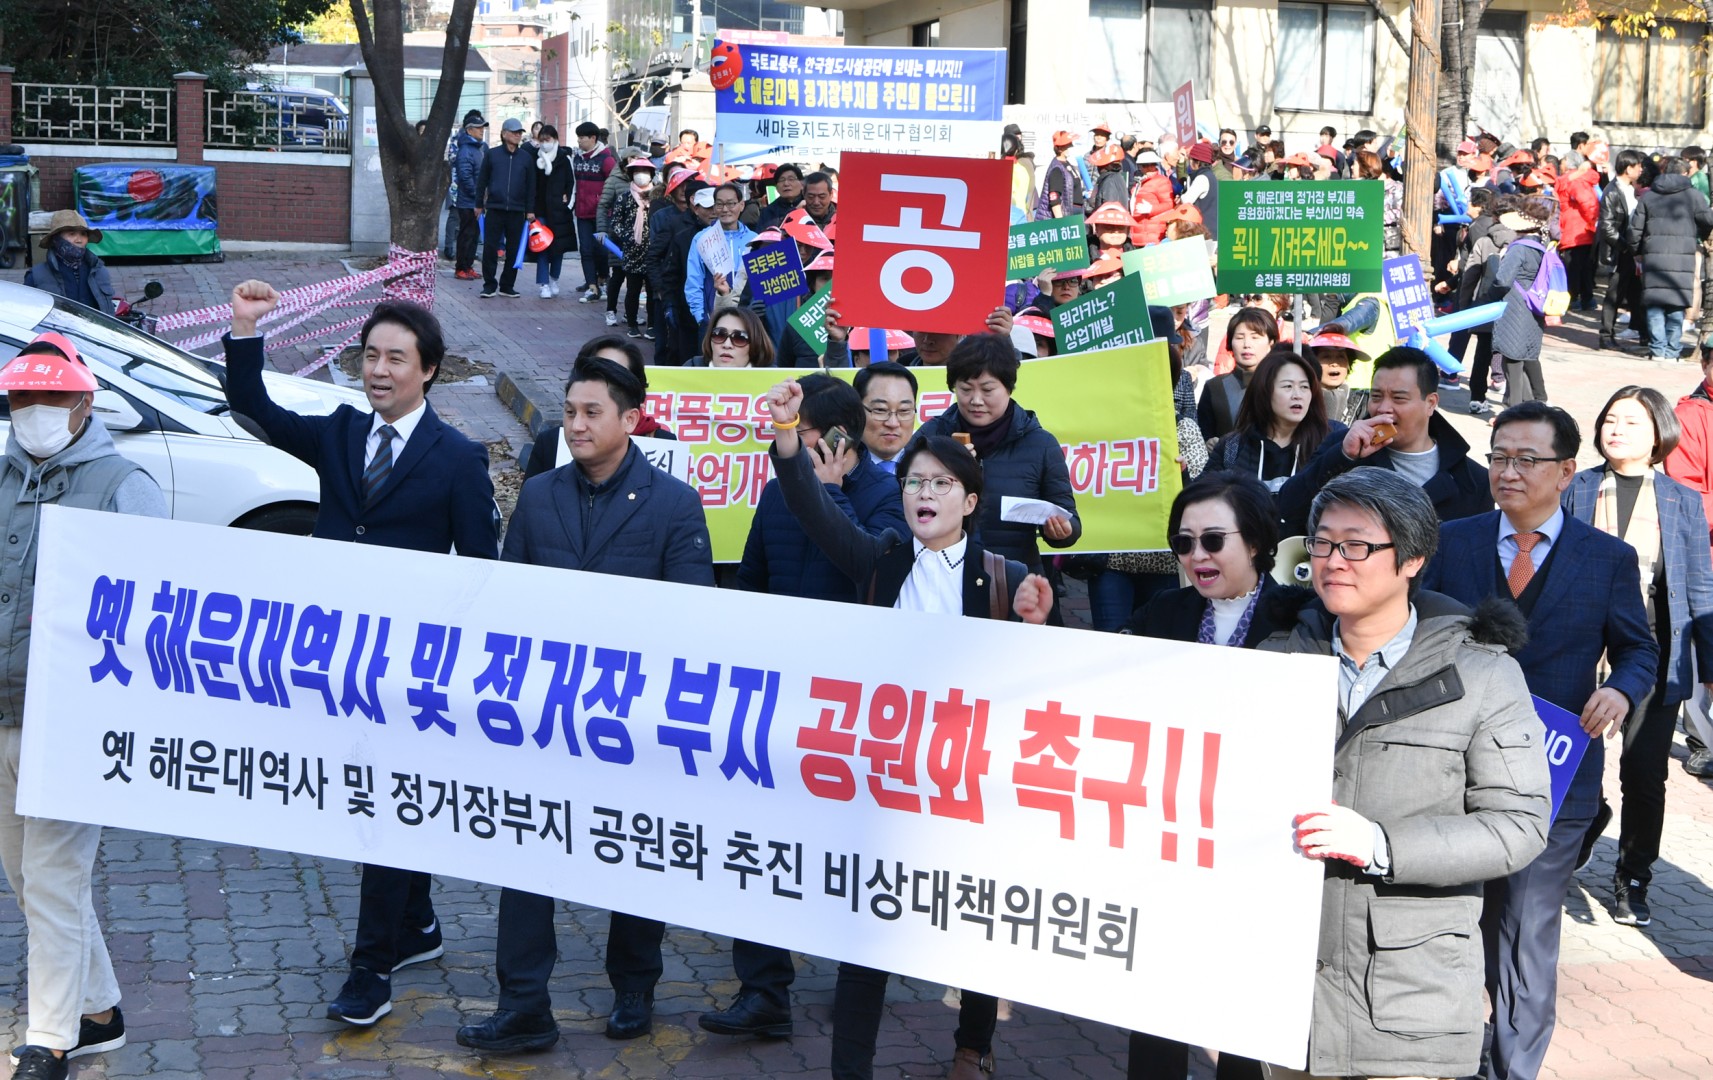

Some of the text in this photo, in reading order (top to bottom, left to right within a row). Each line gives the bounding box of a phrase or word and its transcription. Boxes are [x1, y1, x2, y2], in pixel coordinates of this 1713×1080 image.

[750, 52, 963, 79] 국토교통부, 한국철도시설공단에 보내는 메시지!!
[733, 77, 976, 113] 옛 해운대역 정거장부지를 주민의 품으로!!
[755, 118, 952, 143] 새마을지도자해운대구협의회
[1177, 90, 1194, 144] 원
[1238, 206, 1365, 220] 공원화하겠다는 부산시의 약속
[1244, 190, 1355, 205] 옛 해운대역 정거장 부지를
[863, 173, 981, 311] 공
[1029, 229, 1059, 246] 숨쉬게
[1061, 225, 1081, 241] 하고
[1232, 227, 1259, 267] 꼭!!
[748, 250, 787, 274] 국토부는
[1010, 246, 1083, 270] 사람을 숨쉬게 하자
[760, 269, 801, 296] 각성하라
[1255, 273, 1351, 287] 송정동 주민자치위원회
[1059, 291, 1115, 328] 뭐라카노?
[1065, 315, 1114, 350] 상업개발
[1063, 440, 1157, 494] 하라!
[86, 575, 1221, 869] 옛 해운대역사 및 정거장 부지 공원화 촉구!!
[103, 731, 1139, 971] 옛 해운대역사 및 정거장부지 공원화 추진 비상대책위원회
